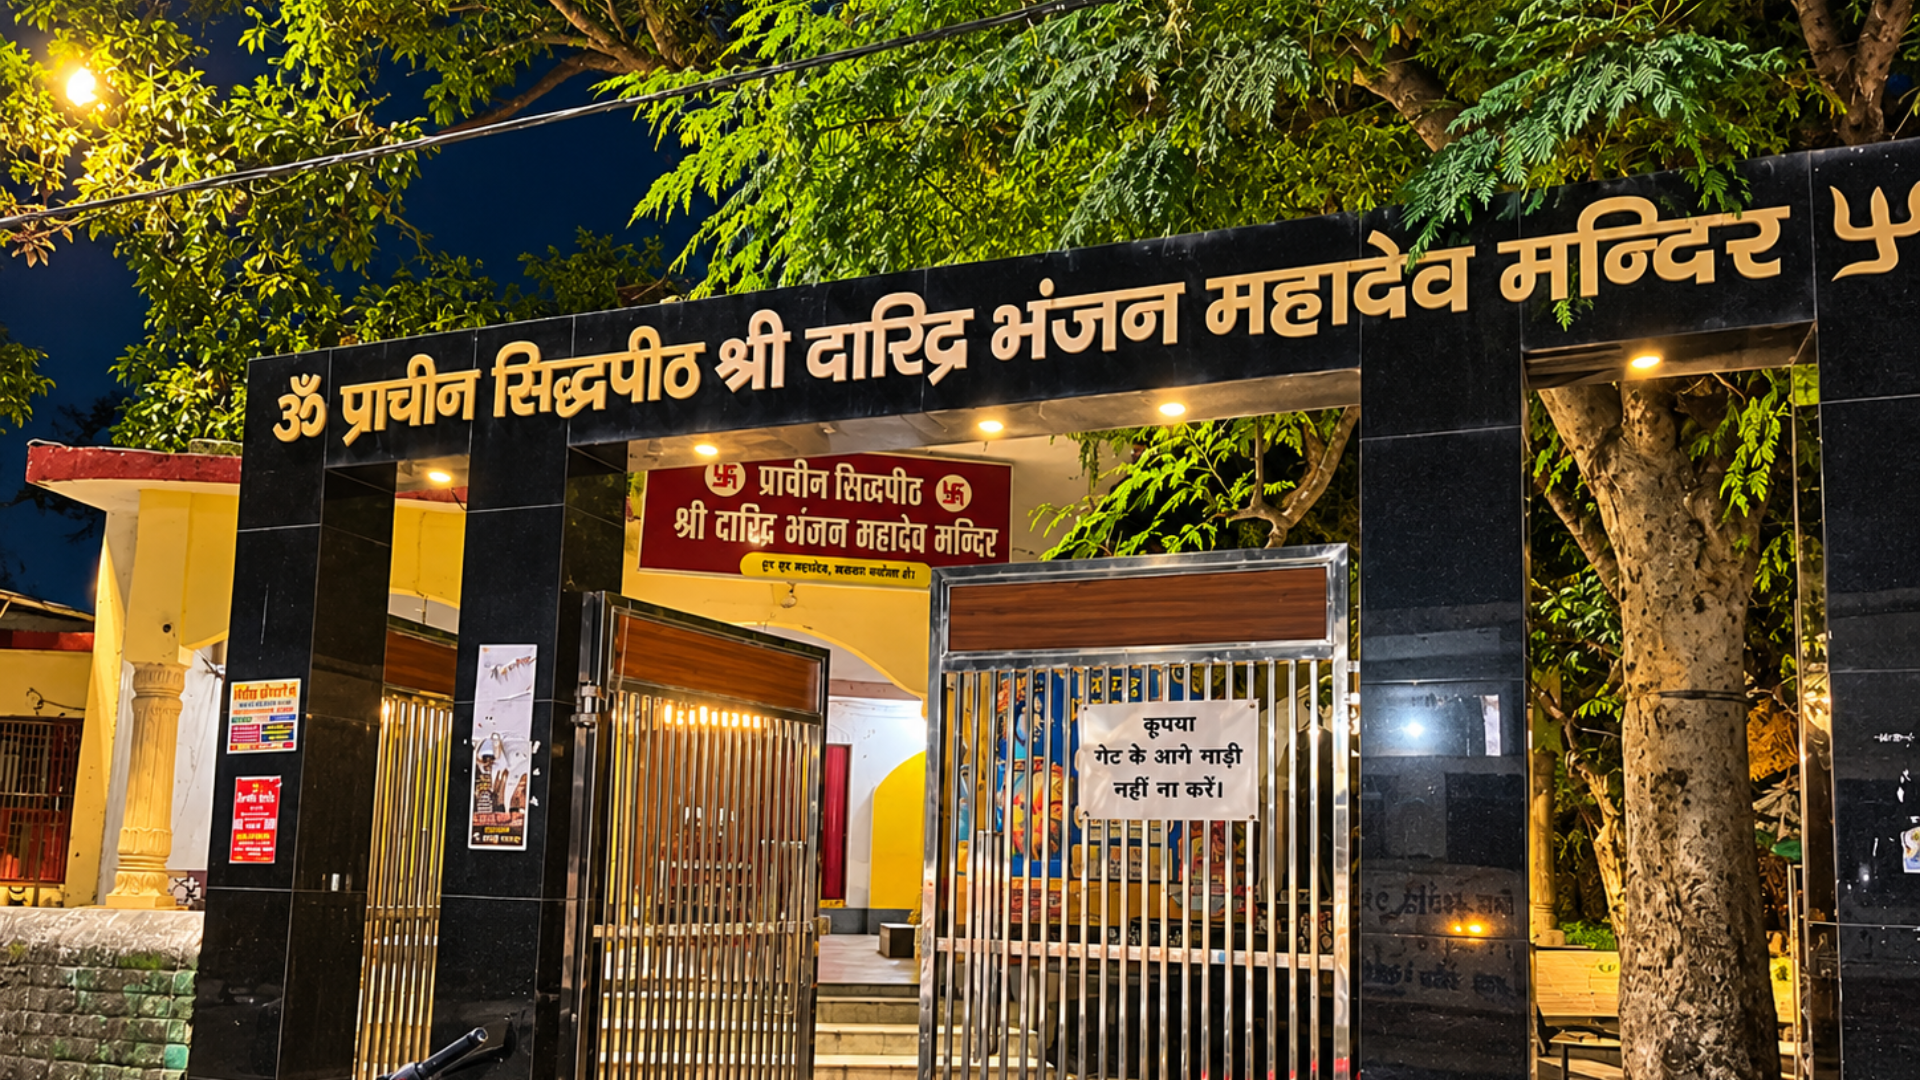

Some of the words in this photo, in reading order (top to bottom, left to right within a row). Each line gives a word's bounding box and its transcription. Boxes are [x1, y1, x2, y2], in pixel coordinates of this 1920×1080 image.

[340, 354, 482, 446] प्राचीन
[492, 325, 706, 418] सिद्धपीठ
[715, 309, 791, 393] श्री
[804, 292, 975, 387] दारिद्र
[990, 277, 1186, 361] भंजन
[1205, 229, 1476, 338] महादेव
[1497, 195, 1790, 303] मन्दिर
[673, 499, 708, 540] श्री
[714, 503, 778, 547] दारिद्र
[785, 507, 850, 548] भंजन
[856, 513, 928, 554] महादेव
[934, 517, 999, 558] मन्दिर
[1094, 744, 1123, 765] गेट
[1128, 743, 1147, 765] के
[1154, 743, 1193, 765] आगे
[1113, 776, 1149, 800] नहीं
[1156, 781, 1180, 798] ना
